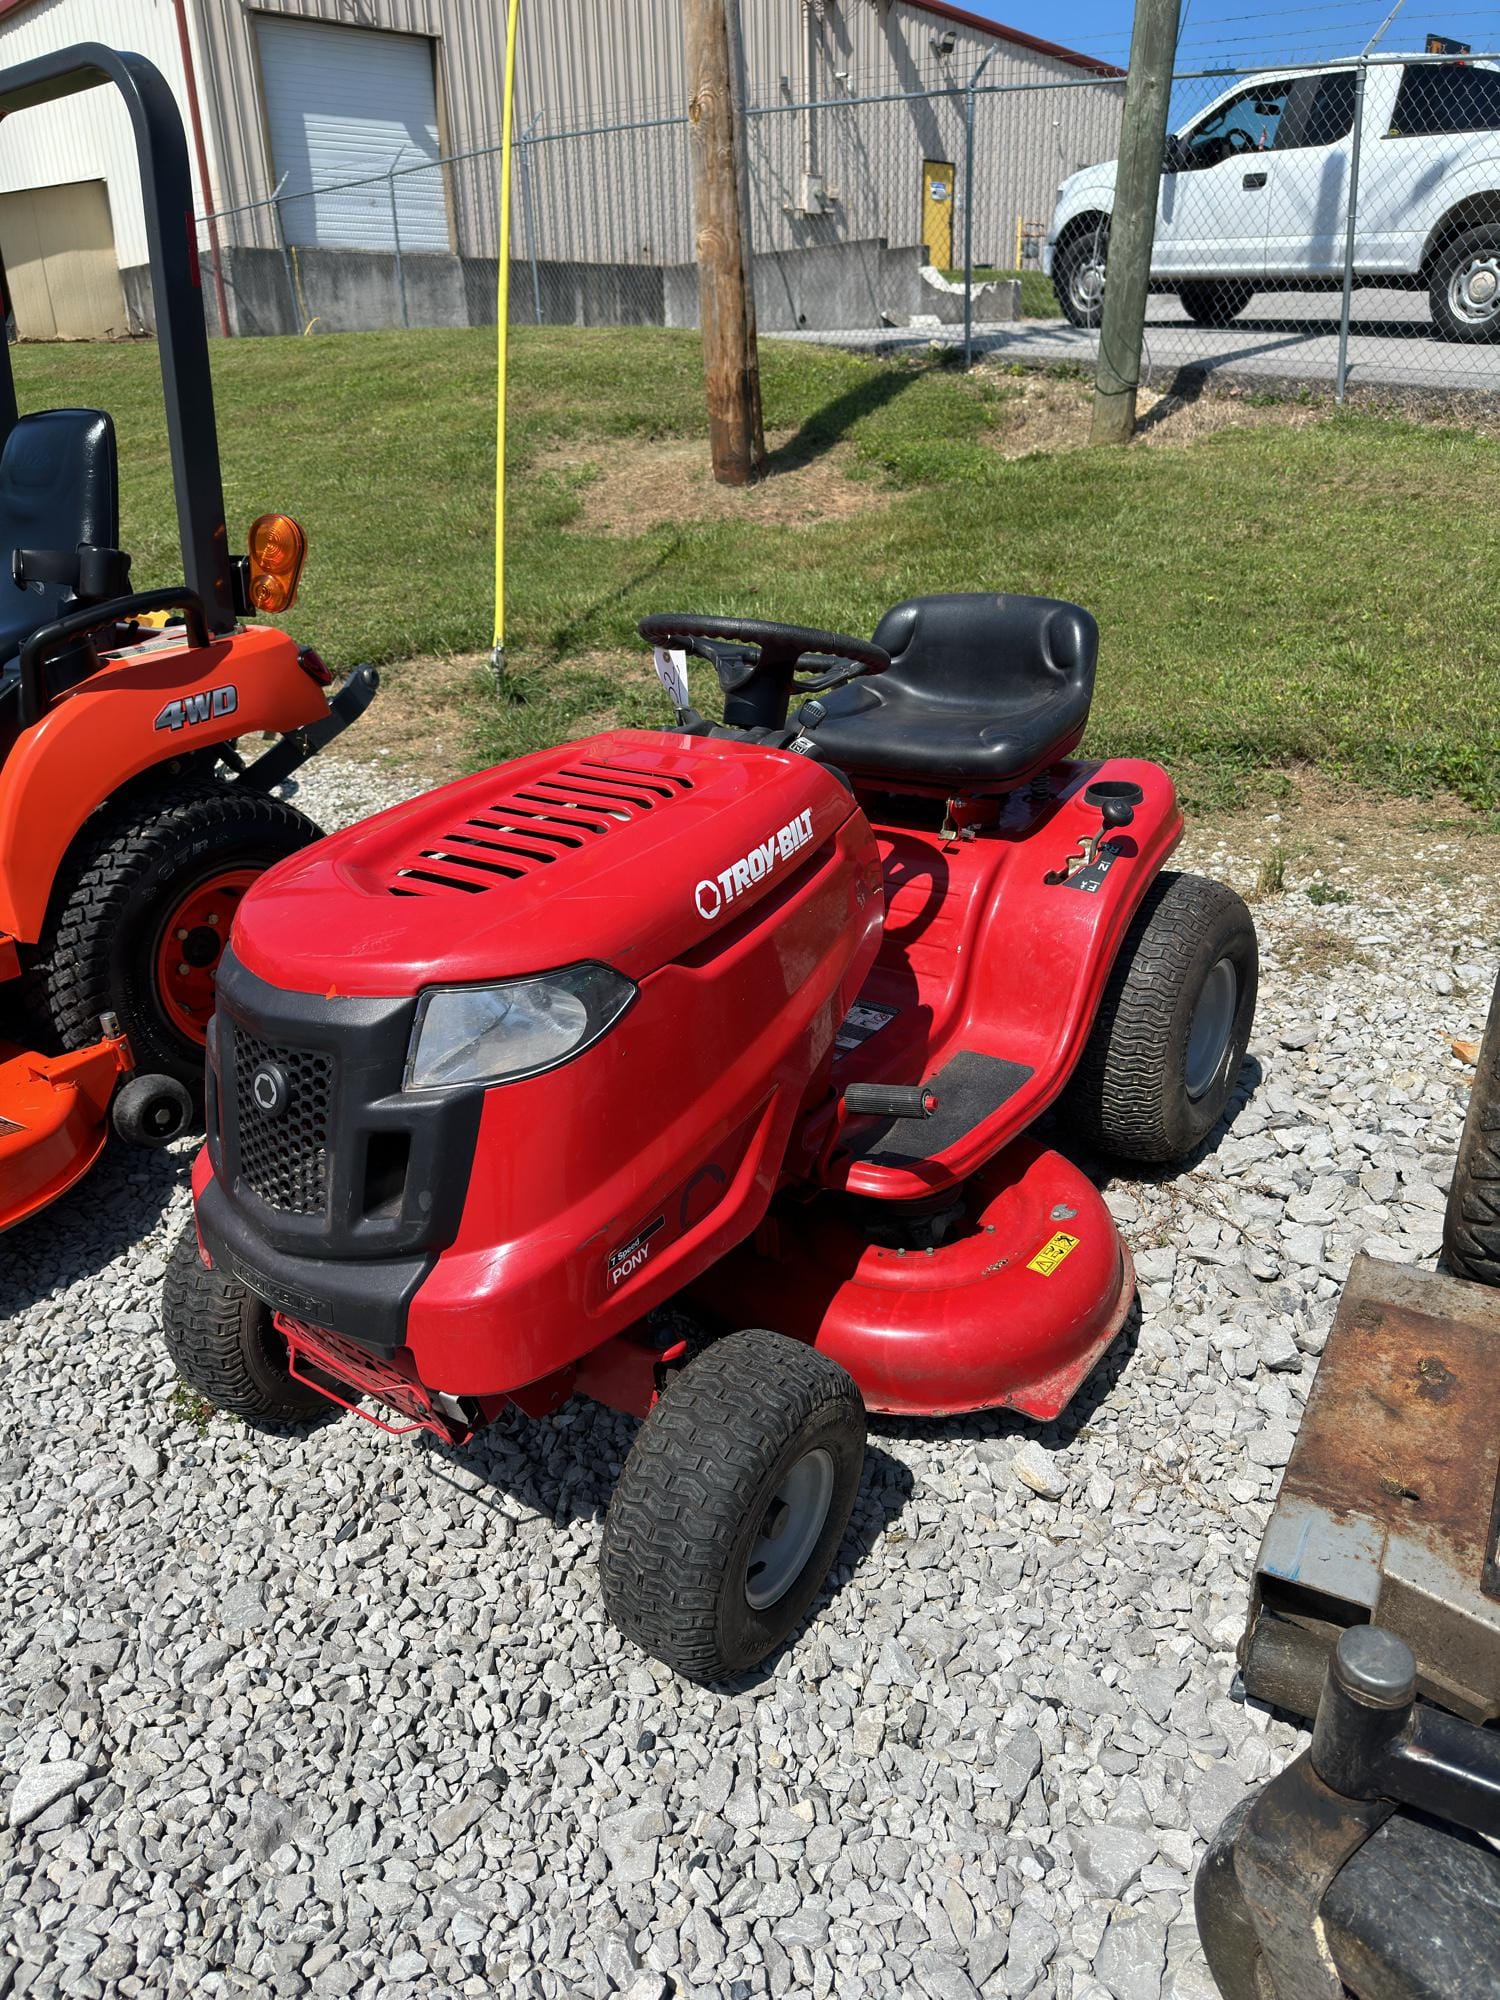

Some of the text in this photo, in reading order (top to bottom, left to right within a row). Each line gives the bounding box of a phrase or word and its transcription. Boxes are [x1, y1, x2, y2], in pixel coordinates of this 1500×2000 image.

[154, 684, 238, 731] 4WD
[716, 807, 814, 904] TROY-BILT
[1097, 864, 1109, 872] N
[610, 1237, 640, 1266] 7 Speed
[612, 1243, 649, 1285] PONY
